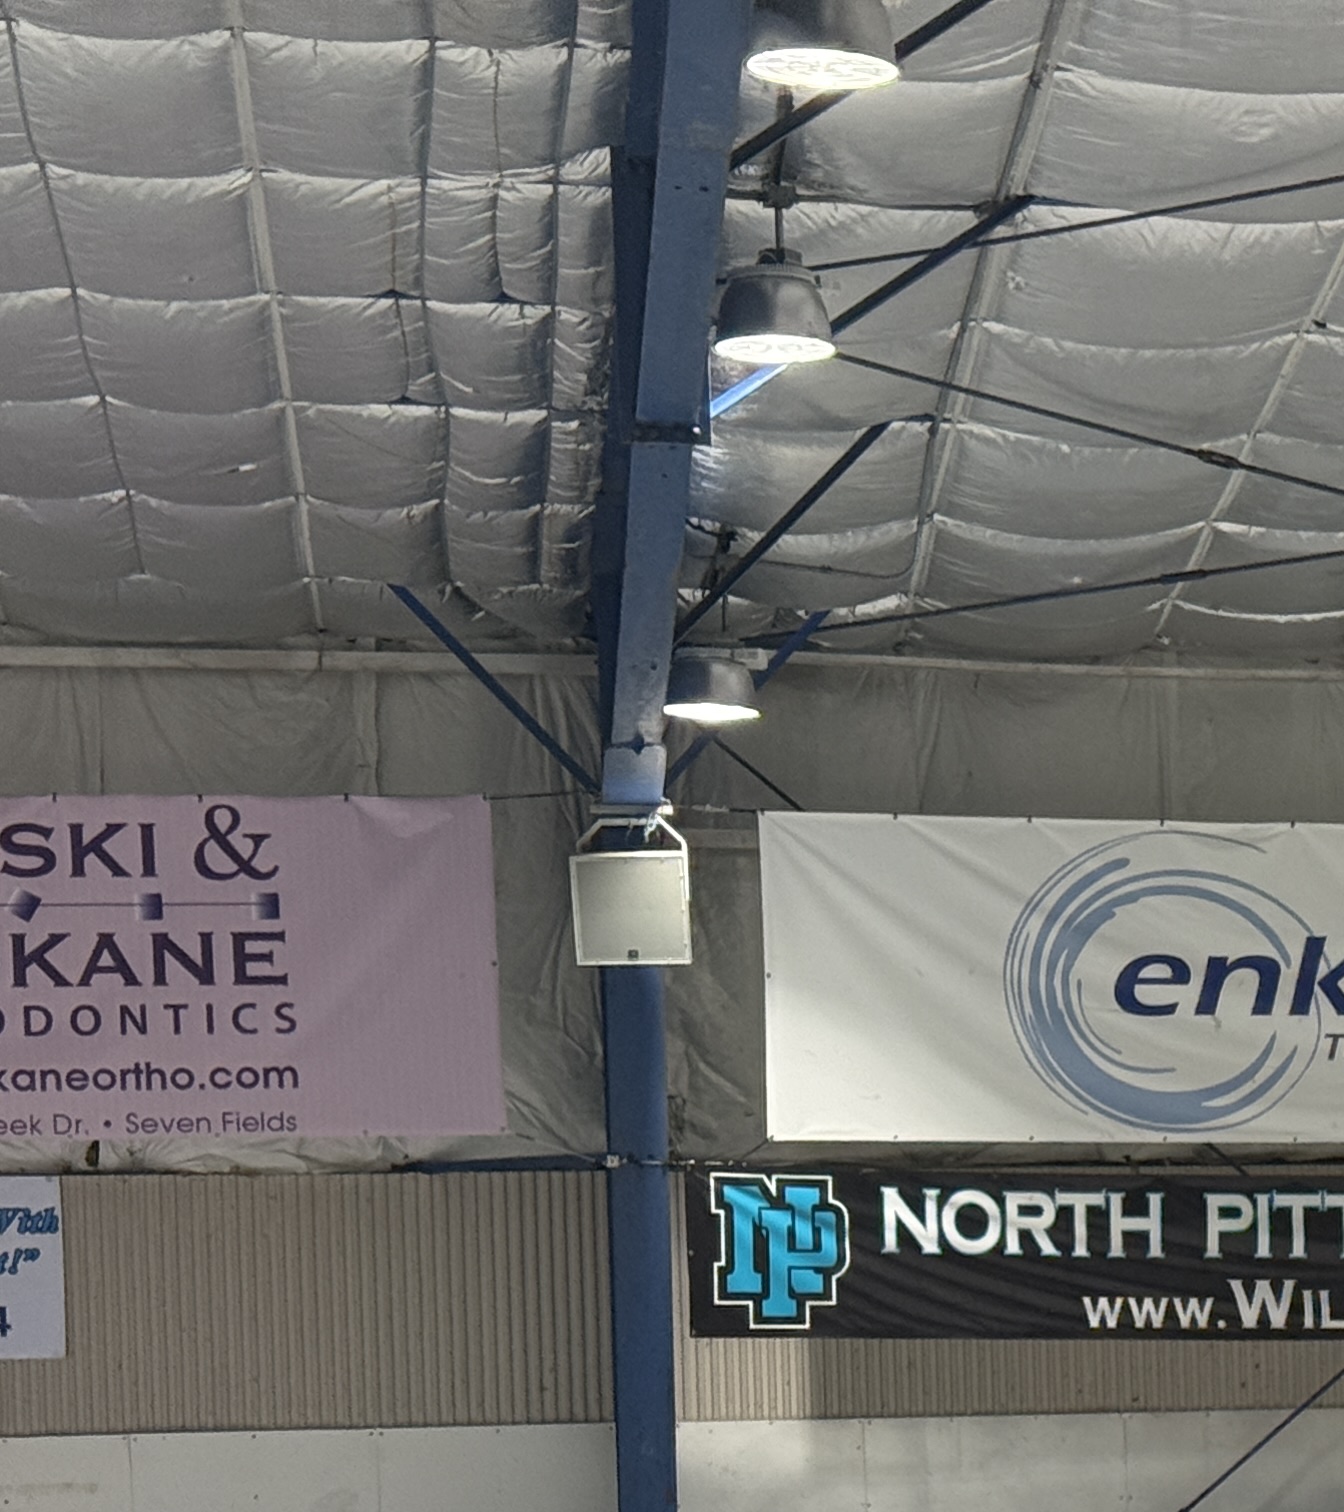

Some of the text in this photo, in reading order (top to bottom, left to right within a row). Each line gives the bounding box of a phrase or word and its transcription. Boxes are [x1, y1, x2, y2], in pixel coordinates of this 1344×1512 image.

[194, 805, 279, 880] &
[9, 930, 288, 988] KANE
[0, 1002, 297, 1037] DONTICS
[53, 1113, 89, 1135] Dr.
[126, 1112, 211, 1134] Seven
[222, 1111, 297, 1134] Fields
[880, 1186, 1165, 1258] NORTH
